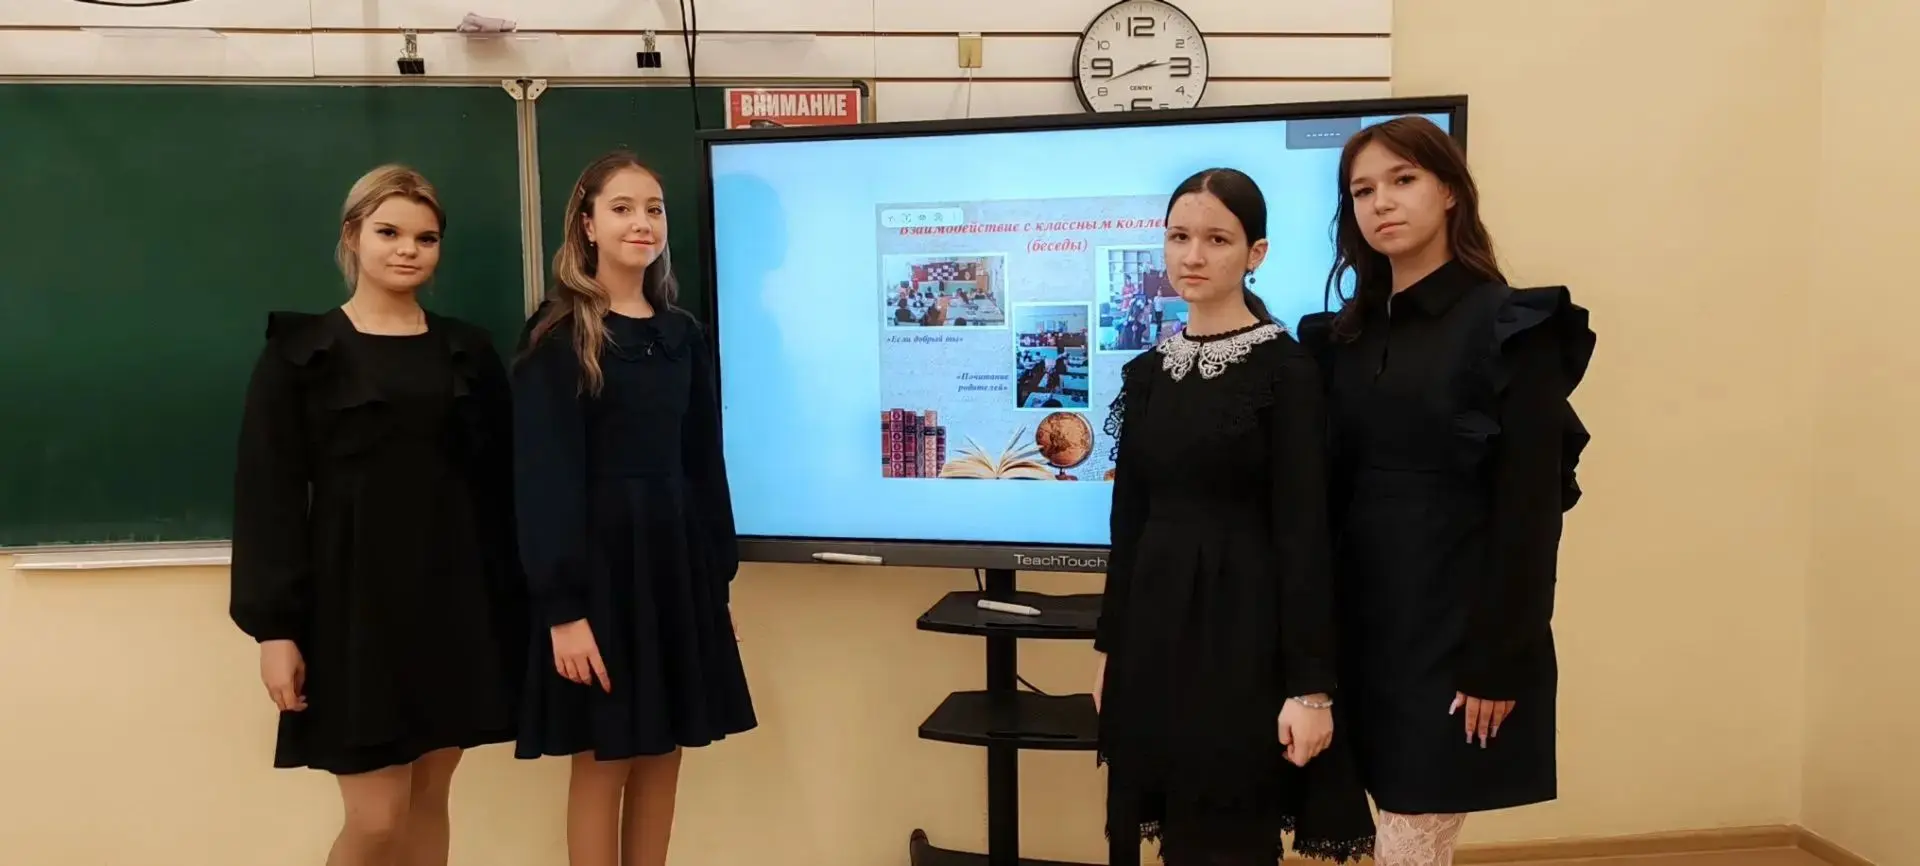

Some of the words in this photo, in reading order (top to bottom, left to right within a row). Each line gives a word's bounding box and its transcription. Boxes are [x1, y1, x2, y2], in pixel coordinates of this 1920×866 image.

[1116, 22, 1121, 31] 11
[1127, 16, 1155, 37] 12
[1097, 40, 1110, 50] 10
[1175, 39, 1185, 49] 2
[1091, 58, 1113, 79] 9
[1169, 57, 1192, 78] 3
[1097, 86, 1108, 97] 8
[1175, 85, 1185, 96] 4
[741, 93, 848, 117] ВНИМАНИЕ
[1023, 222, 1031, 233] с
[1035, 218, 1112, 232] классным
[1026, 238, 1088, 253] (беседы)
[1013, 553, 1107, 567] TeachTouch
